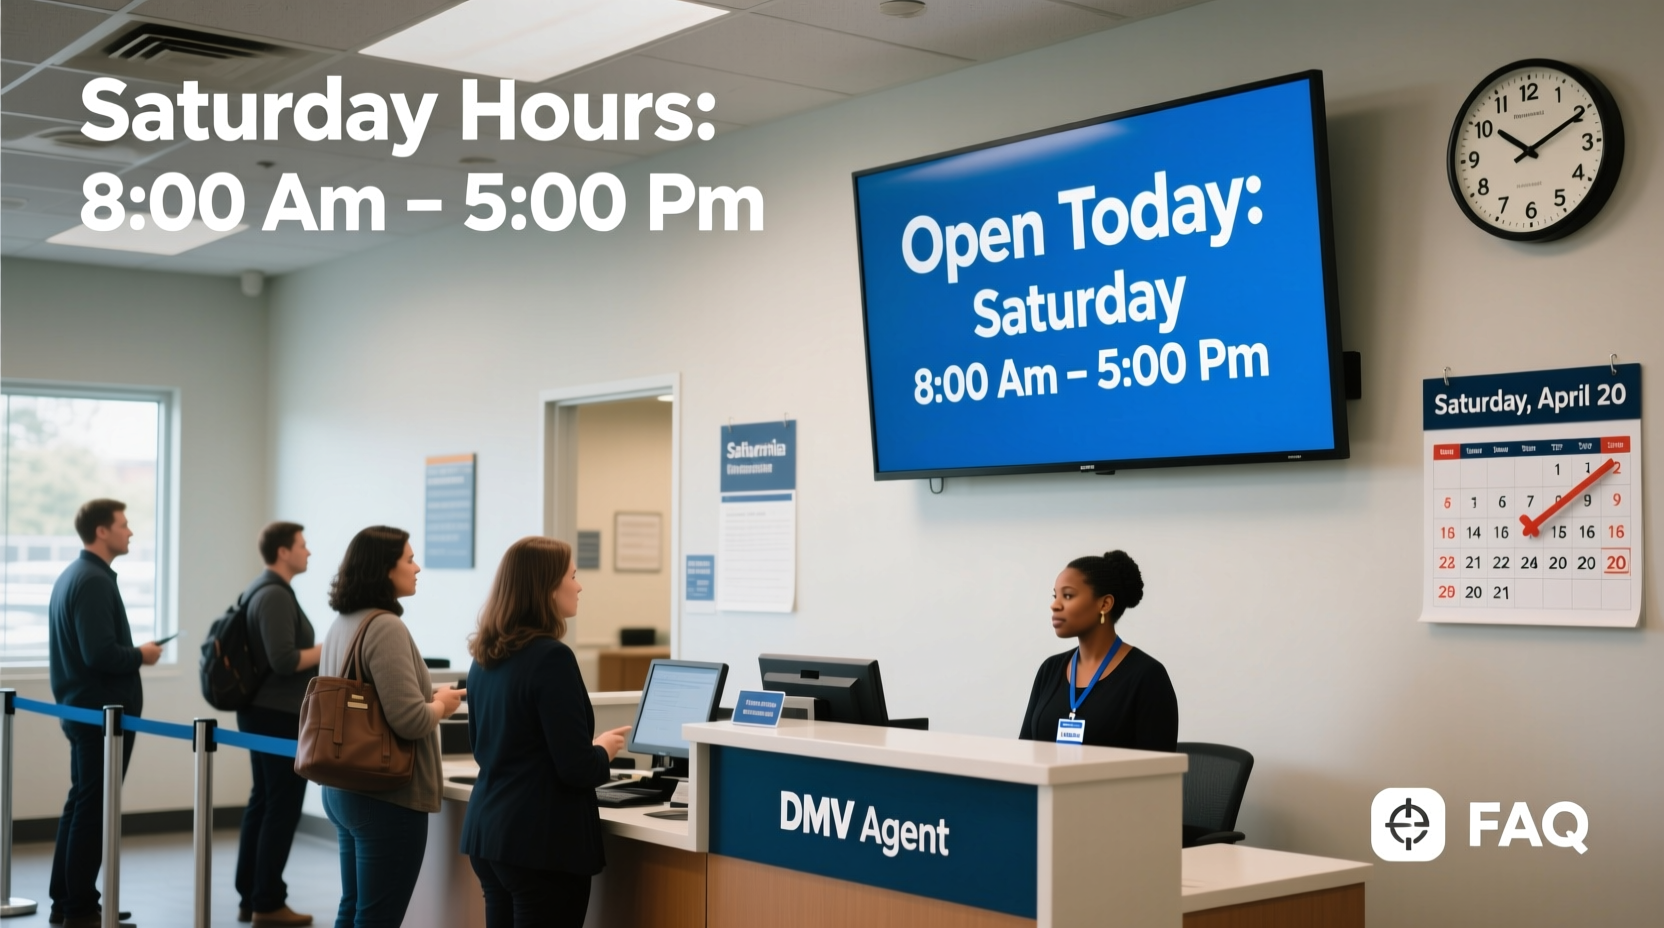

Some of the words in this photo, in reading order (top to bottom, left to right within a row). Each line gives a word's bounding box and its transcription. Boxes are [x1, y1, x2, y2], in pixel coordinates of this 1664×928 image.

[1519, 83, 1539, 102] 12
[1554, 86, 1561, 103] 1
[1494, 95, 1507, 114] 11
[1574, 105, 1585, 123] 2
[1474, 120, 1493, 138] 10
[1582, 133, 1594, 151] 3
[1469, 151, 1480, 168] 9
[1572, 164, 1585, 181] 4
[1478, 178, 1489, 195] 8
[1498, 196, 1509, 214] 7
[1554, 189, 1566, 206] 5
[1526, 202, 1537, 219] 6
[901, 210, 1045, 284] Open
[1057, 170, 1263, 251] Today:
[973, 269, 1187, 340] Saturday
[913, 361, 989, 406] 8:00
[997, 358, 1058, 399] Am
[1097, 342, 1187, 390] 5:00
[1198, 338, 1270, 382] Pm
[1434, 389, 1532, 416] Saturday,
[1538, 384, 1590, 413] April
[1597, 383, 1626, 406] 20
[1554, 463, 1560, 476] 1
[1612, 461, 1622, 474] 2
[1498, 496, 1506, 508] 6
[1527, 495, 1534, 508] 7
[1612, 493, 1621, 506] 9
[1466, 526, 1481, 539] 14
[1494, 526, 1509, 538] 16
[1580, 525, 1595, 538] 16
[1609, 525, 1625, 538] 16
[1466, 556, 1481, 569] 21
[1492, 556, 1510, 569] 22
[1549, 556, 1567, 569] 20
[1577, 556, 1596, 570] 20
[1607, 555, 1626, 570] 20
[1465, 586, 1482, 598] 20
[1493, 586, 1509, 599] 21
[780, 790, 856, 841] DMV
[859, 805, 951, 858] Agent
